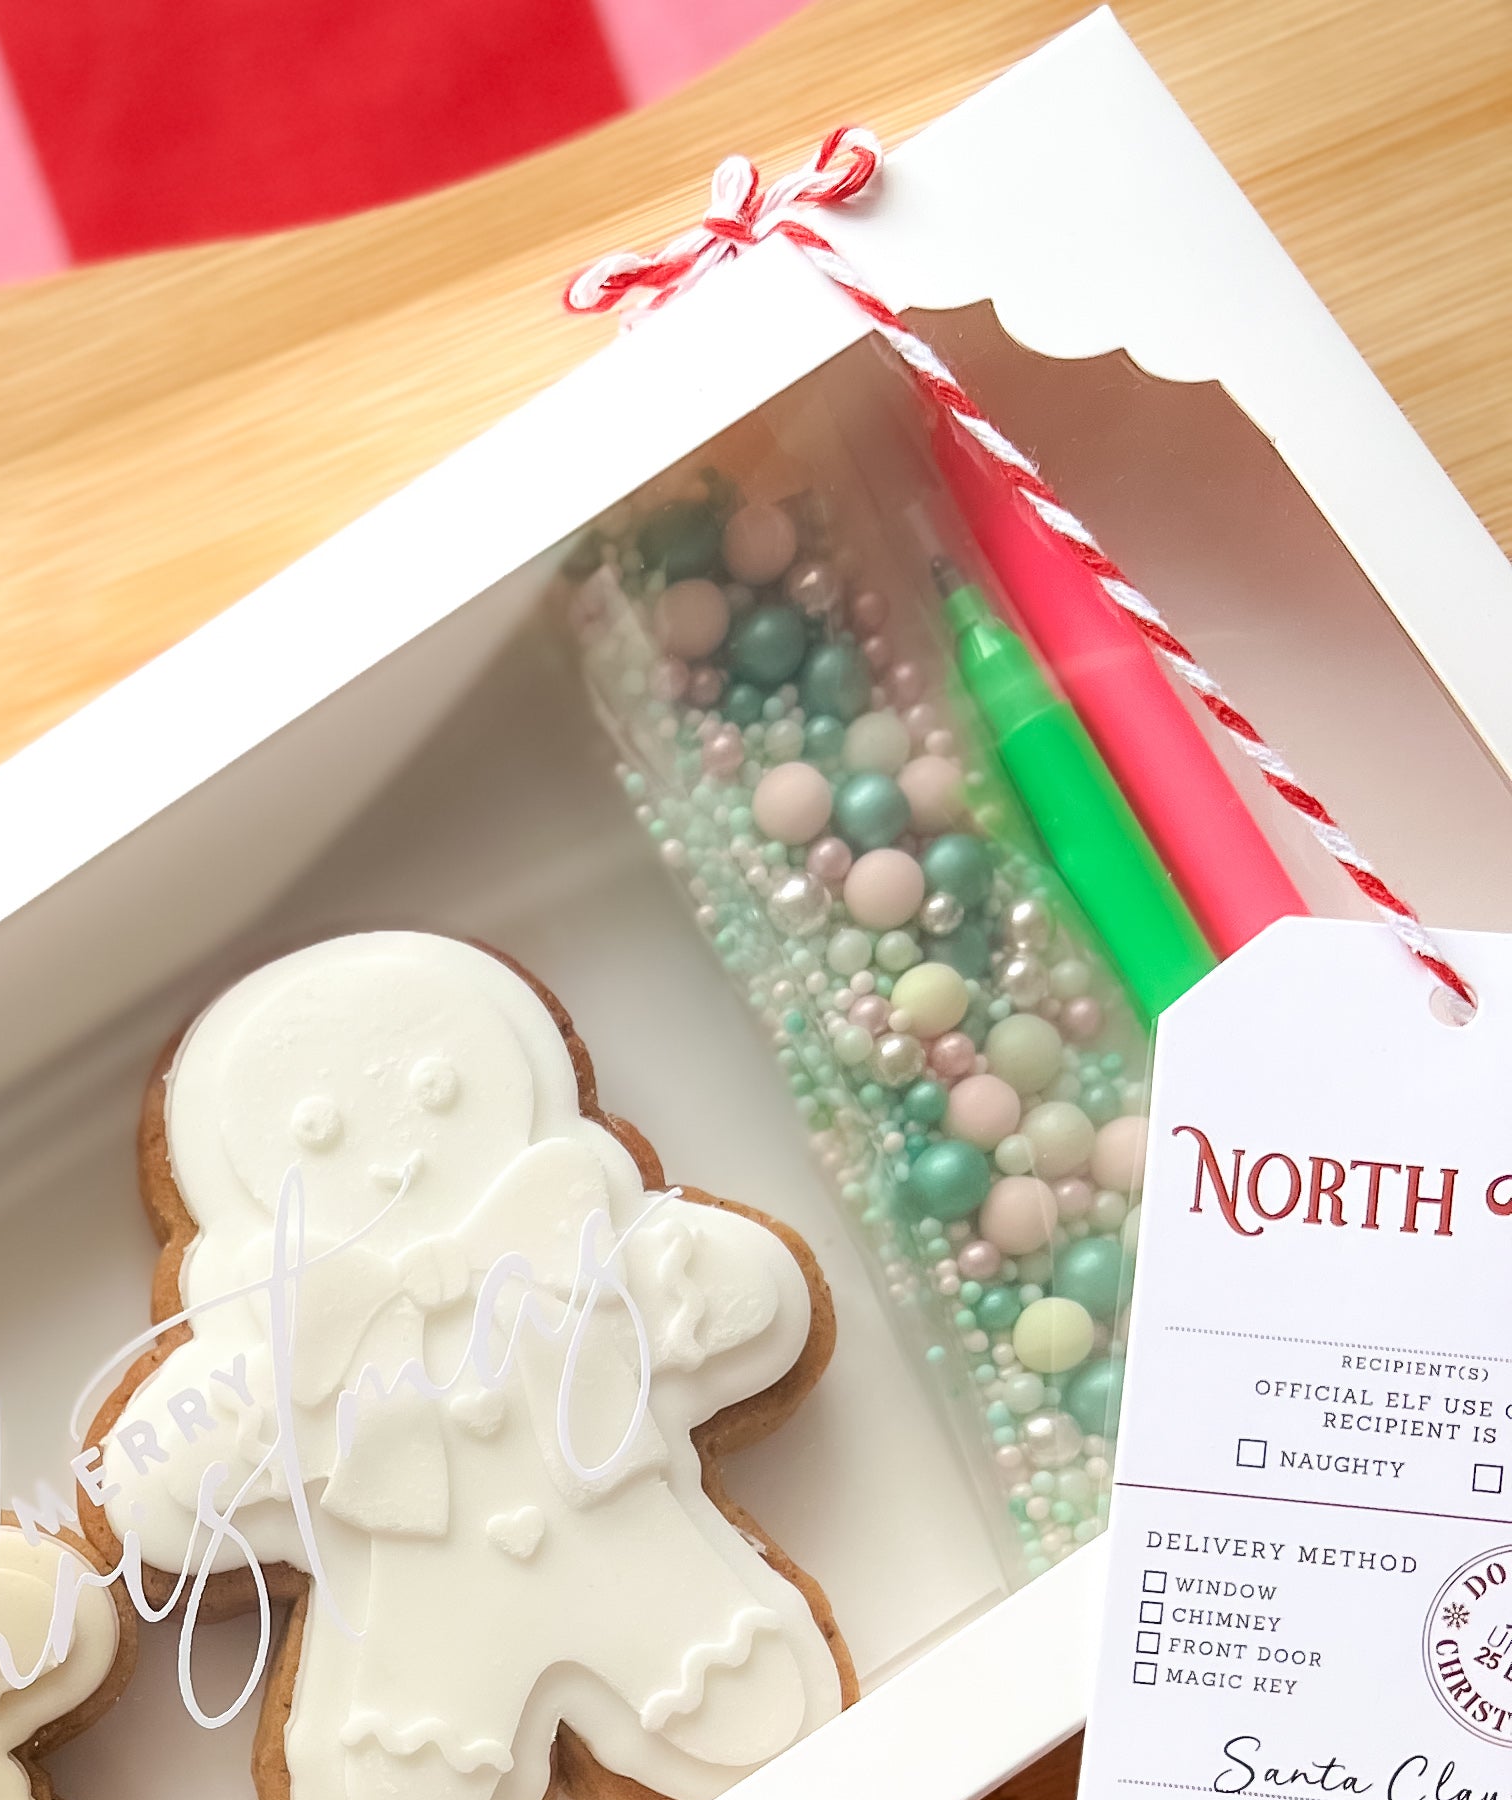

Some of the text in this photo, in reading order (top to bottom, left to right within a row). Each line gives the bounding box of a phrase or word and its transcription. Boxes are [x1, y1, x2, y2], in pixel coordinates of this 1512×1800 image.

[1172, 1125, 1458, 1237] NORTH
[1341, 1355, 1489, 1383] RECIPIENT(S)
[1255, 1379, 1374, 1407] OFFICIAL
[1386, 1392, 1432, 1412] ELF
[1445, 1397, 1494, 1418] USE
[1323, 1411, 1497, 1443] RECIPIENT IS
[12, 1352, 255, 1547] MERRY
[1280, 1450, 1405, 1479] NAUGHTY
[1146, 1530, 1418, 1574] DELIVERY METHOD
[1175, 1576, 1278, 1600] WINDOW
[1462, 1562, 1507, 1601] DO
[1172, 1608, 1282, 1633] CHIMNEY
[1168, 1638, 1323, 1668] FRONT DOOR
[1166, 1668, 1298, 1695] MAGIC KEY
[1436, 1639, 1512, 1733] CHRIST
[1214, 1736, 1372, 1794] Santa
